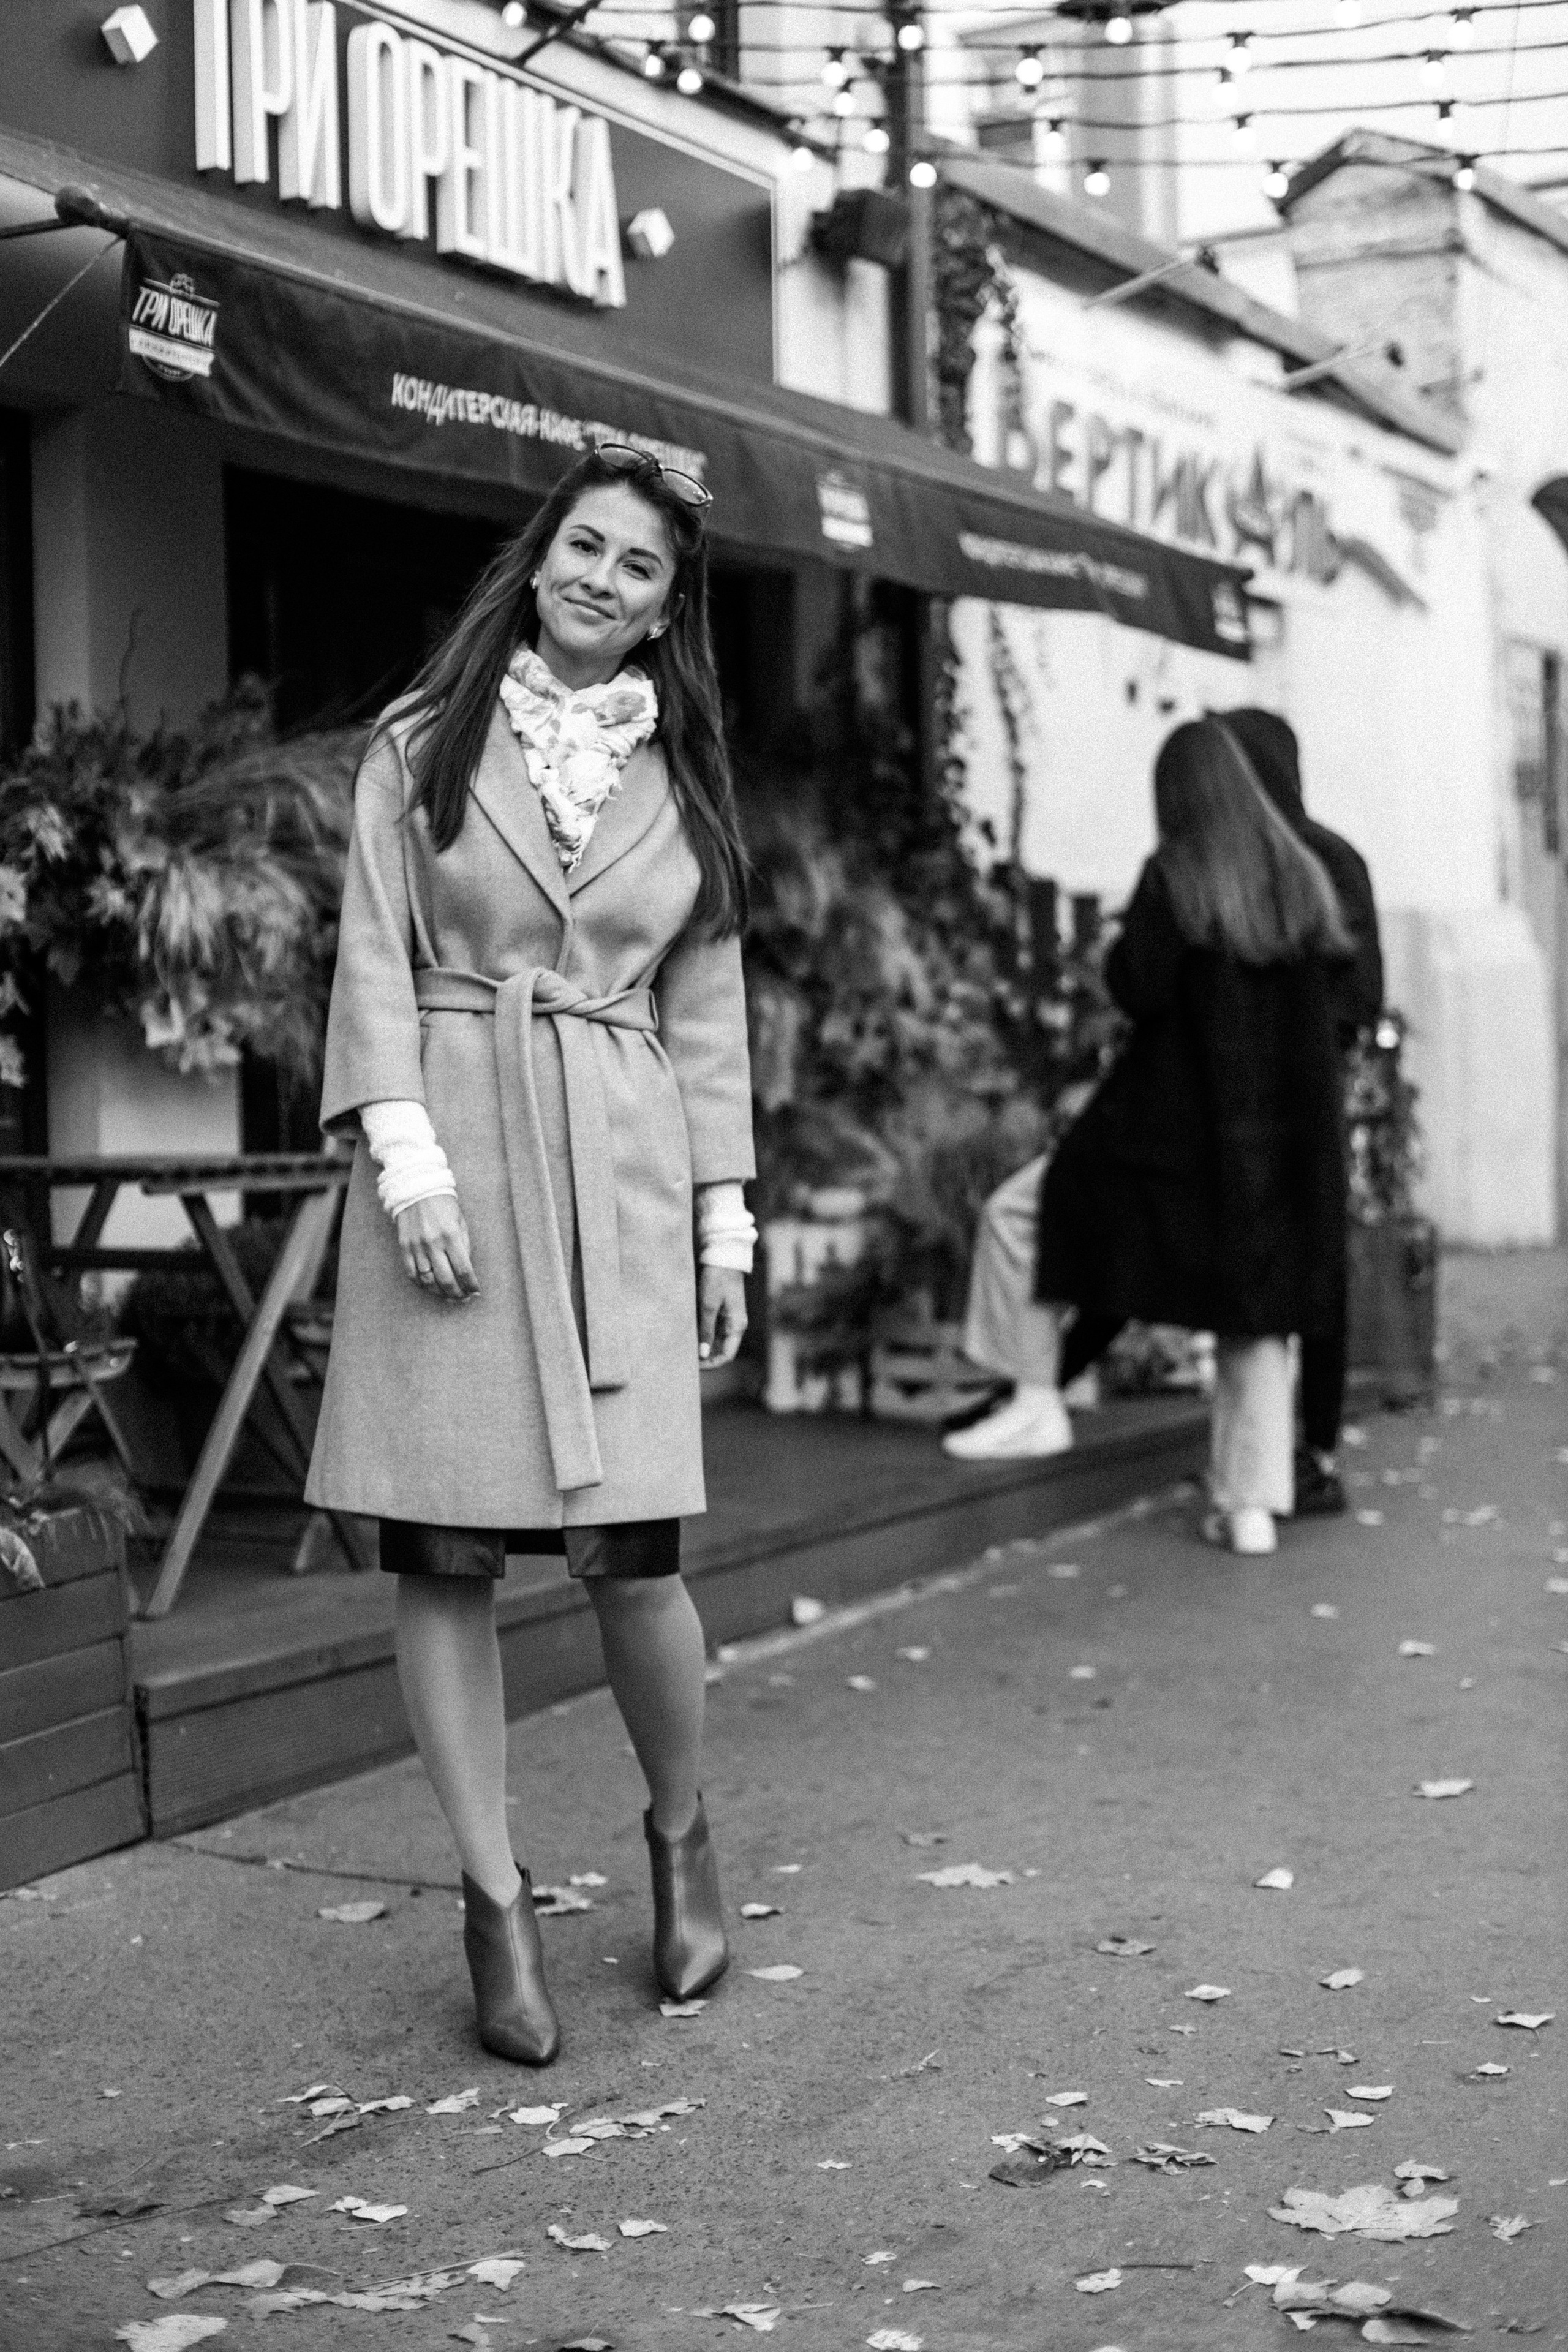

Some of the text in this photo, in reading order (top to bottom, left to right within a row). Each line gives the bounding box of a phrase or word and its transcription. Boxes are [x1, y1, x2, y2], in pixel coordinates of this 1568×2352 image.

[347, 21, 627, 309] ОРЕШКА
[132, 286, 217, 347] ТРИ ОРЕШКА
